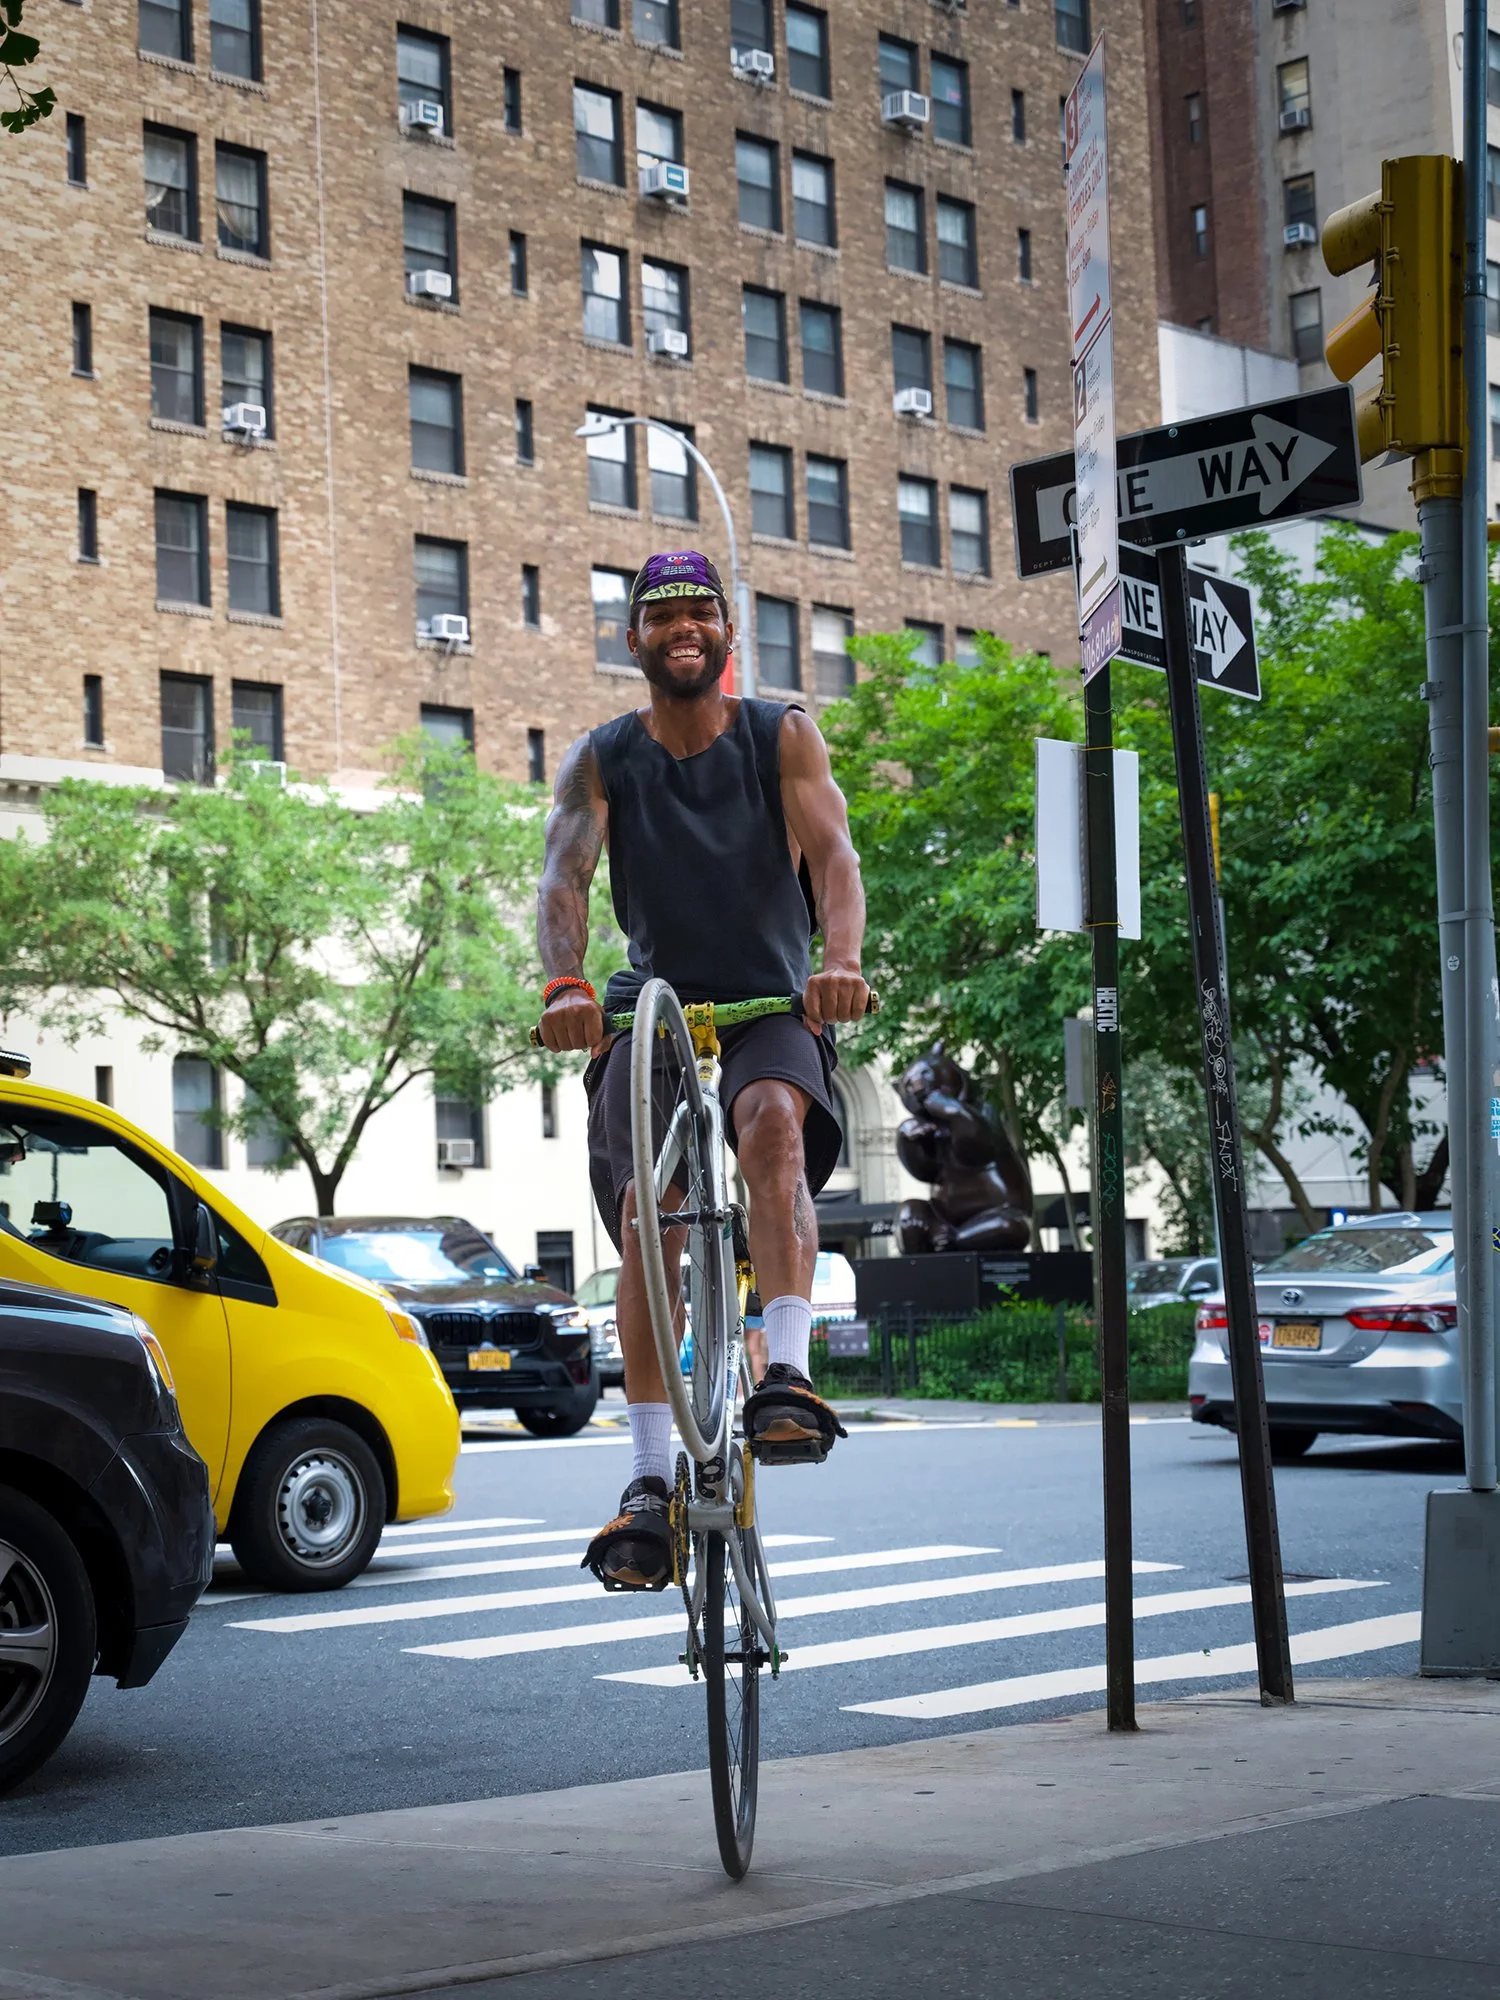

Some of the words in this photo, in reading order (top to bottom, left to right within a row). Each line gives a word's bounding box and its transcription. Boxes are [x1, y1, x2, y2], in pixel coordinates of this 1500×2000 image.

[1069, 100, 1075, 149] 3
[1077, 369, 1084, 421] 2
[1198, 436, 1299, 498] WAY
[1123, 581, 1158, 633] NE
[1121, 647, 1160, 662] RANSPORTATION
[1096, 986, 1118, 1033] HEKTIC
